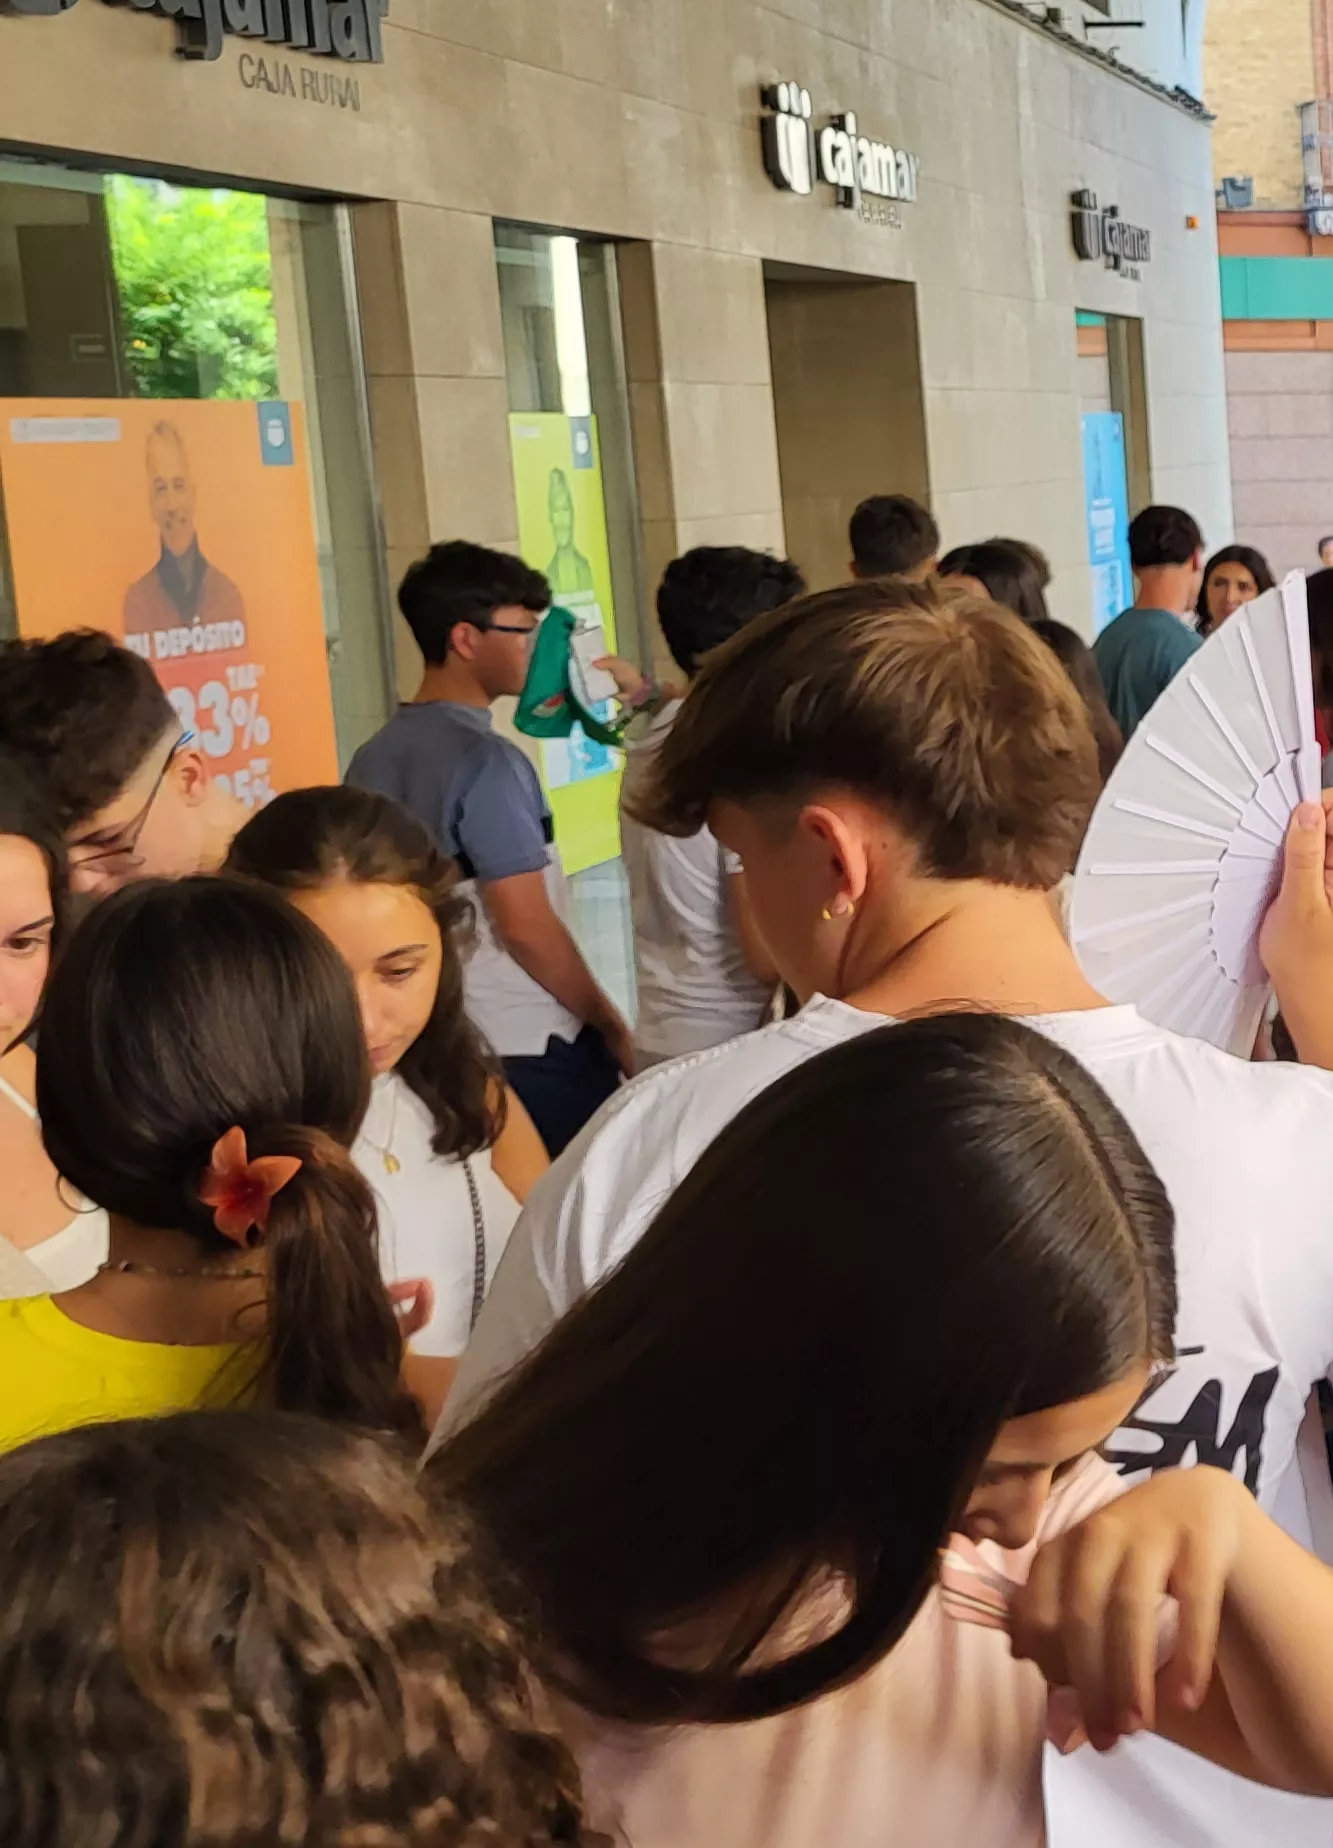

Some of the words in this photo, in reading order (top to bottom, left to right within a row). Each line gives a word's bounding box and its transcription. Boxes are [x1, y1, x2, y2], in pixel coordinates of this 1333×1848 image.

[238, 53, 298, 99] CAJA
[814, 109, 921, 212] cajamar
[154, 615, 246, 660] DEPÓSITO
